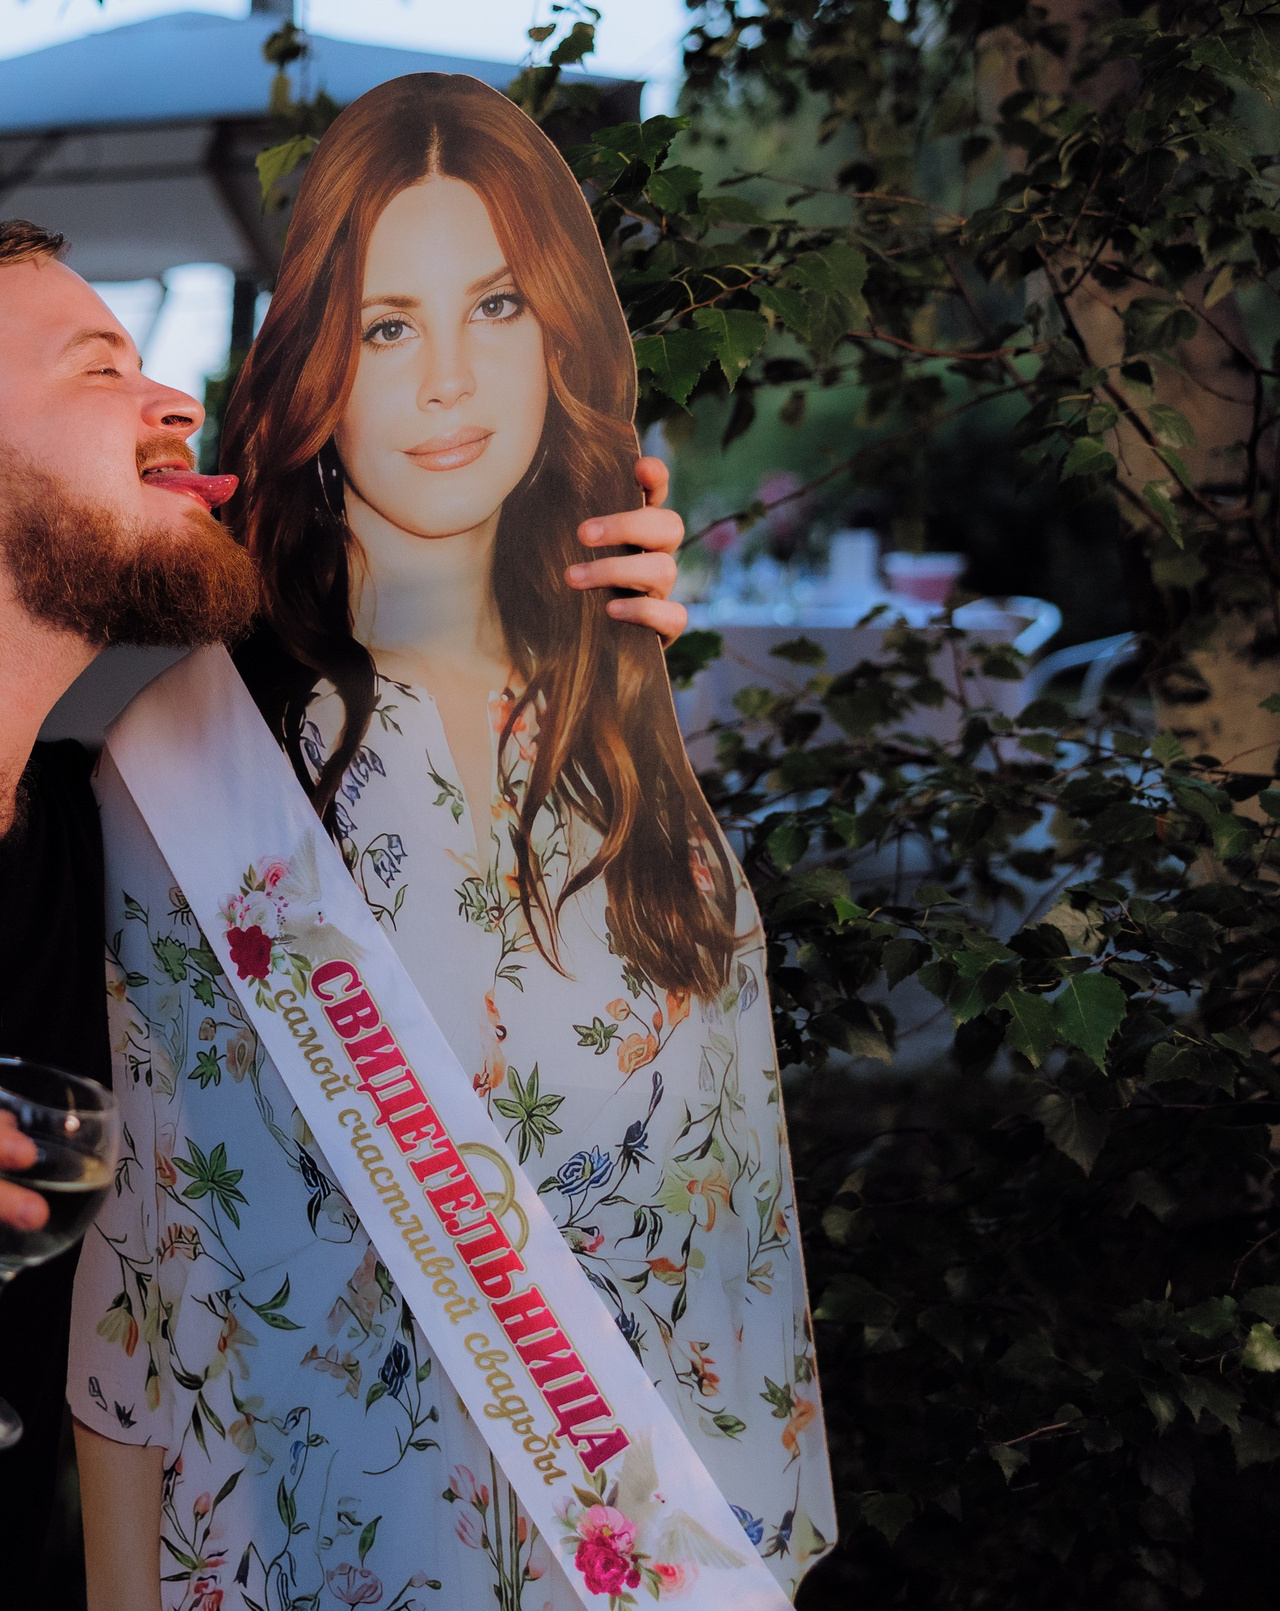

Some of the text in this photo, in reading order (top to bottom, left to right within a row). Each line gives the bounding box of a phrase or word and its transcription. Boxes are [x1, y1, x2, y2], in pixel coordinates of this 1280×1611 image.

[273, 988, 568, 1486] самой счастливой свадьбы
[310, 959, 631, 1474] СВИДЕТЕЛЬНИЦА
